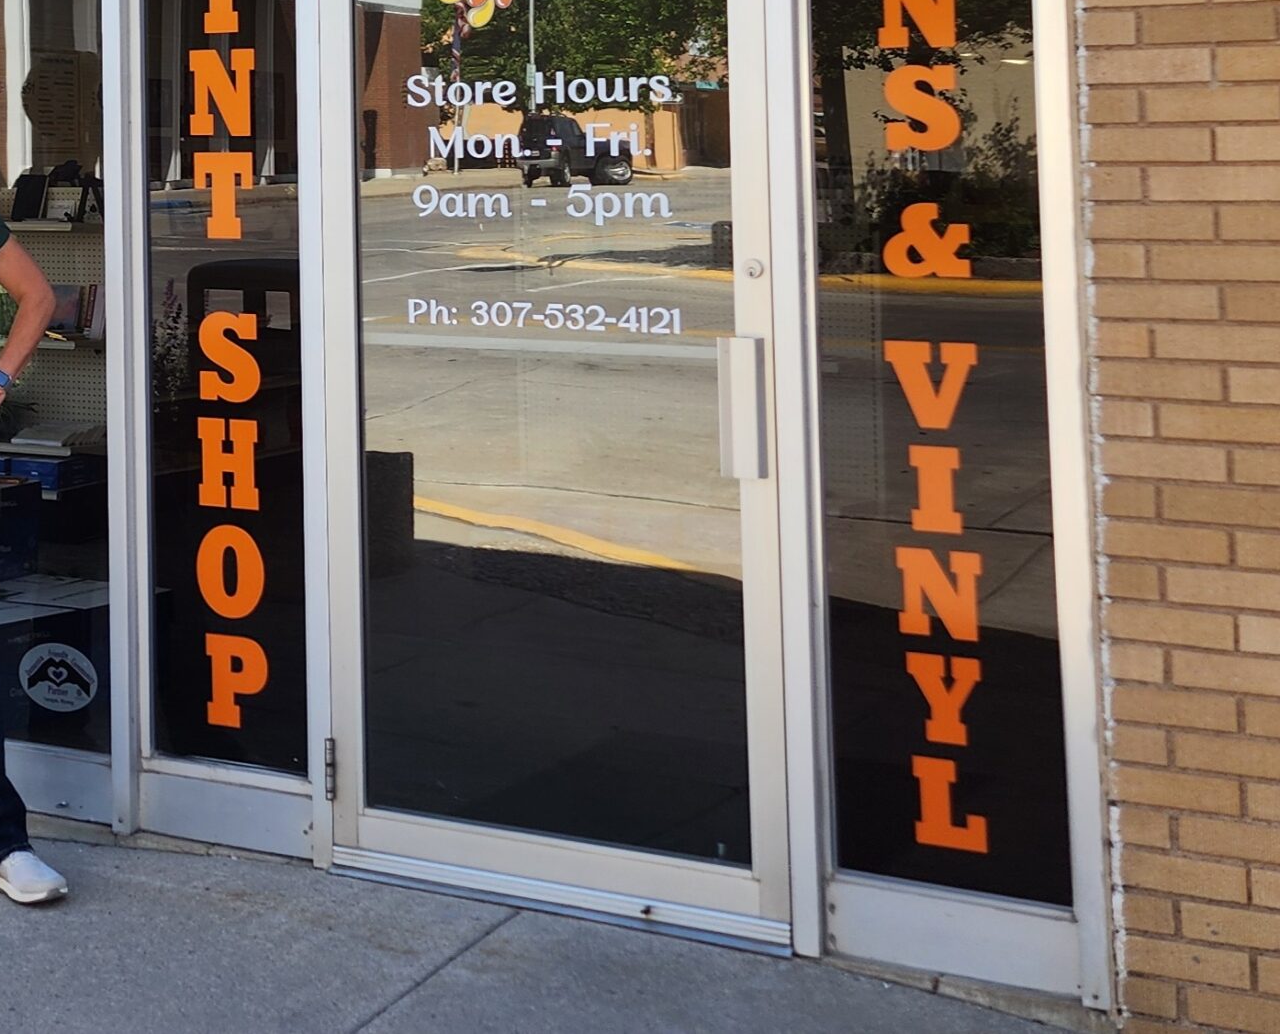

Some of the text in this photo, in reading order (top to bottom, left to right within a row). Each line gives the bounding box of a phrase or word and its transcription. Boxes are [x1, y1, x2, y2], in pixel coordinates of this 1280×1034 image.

[406, 71, 673, 108] Store Hours
[427, 126, 532, 159] Mon.
[584, 122, 653, 158] Fri.
[412, 184, 513, 219] 9am
[566, 183, 673, 226] 5pm
[882, 201, 973, 279] &
[406, 298, 682, 335] Ph: 307-532-4121
[196, 311, 269, 729] SHOP
[883, 340, 989, 854] VINYL
